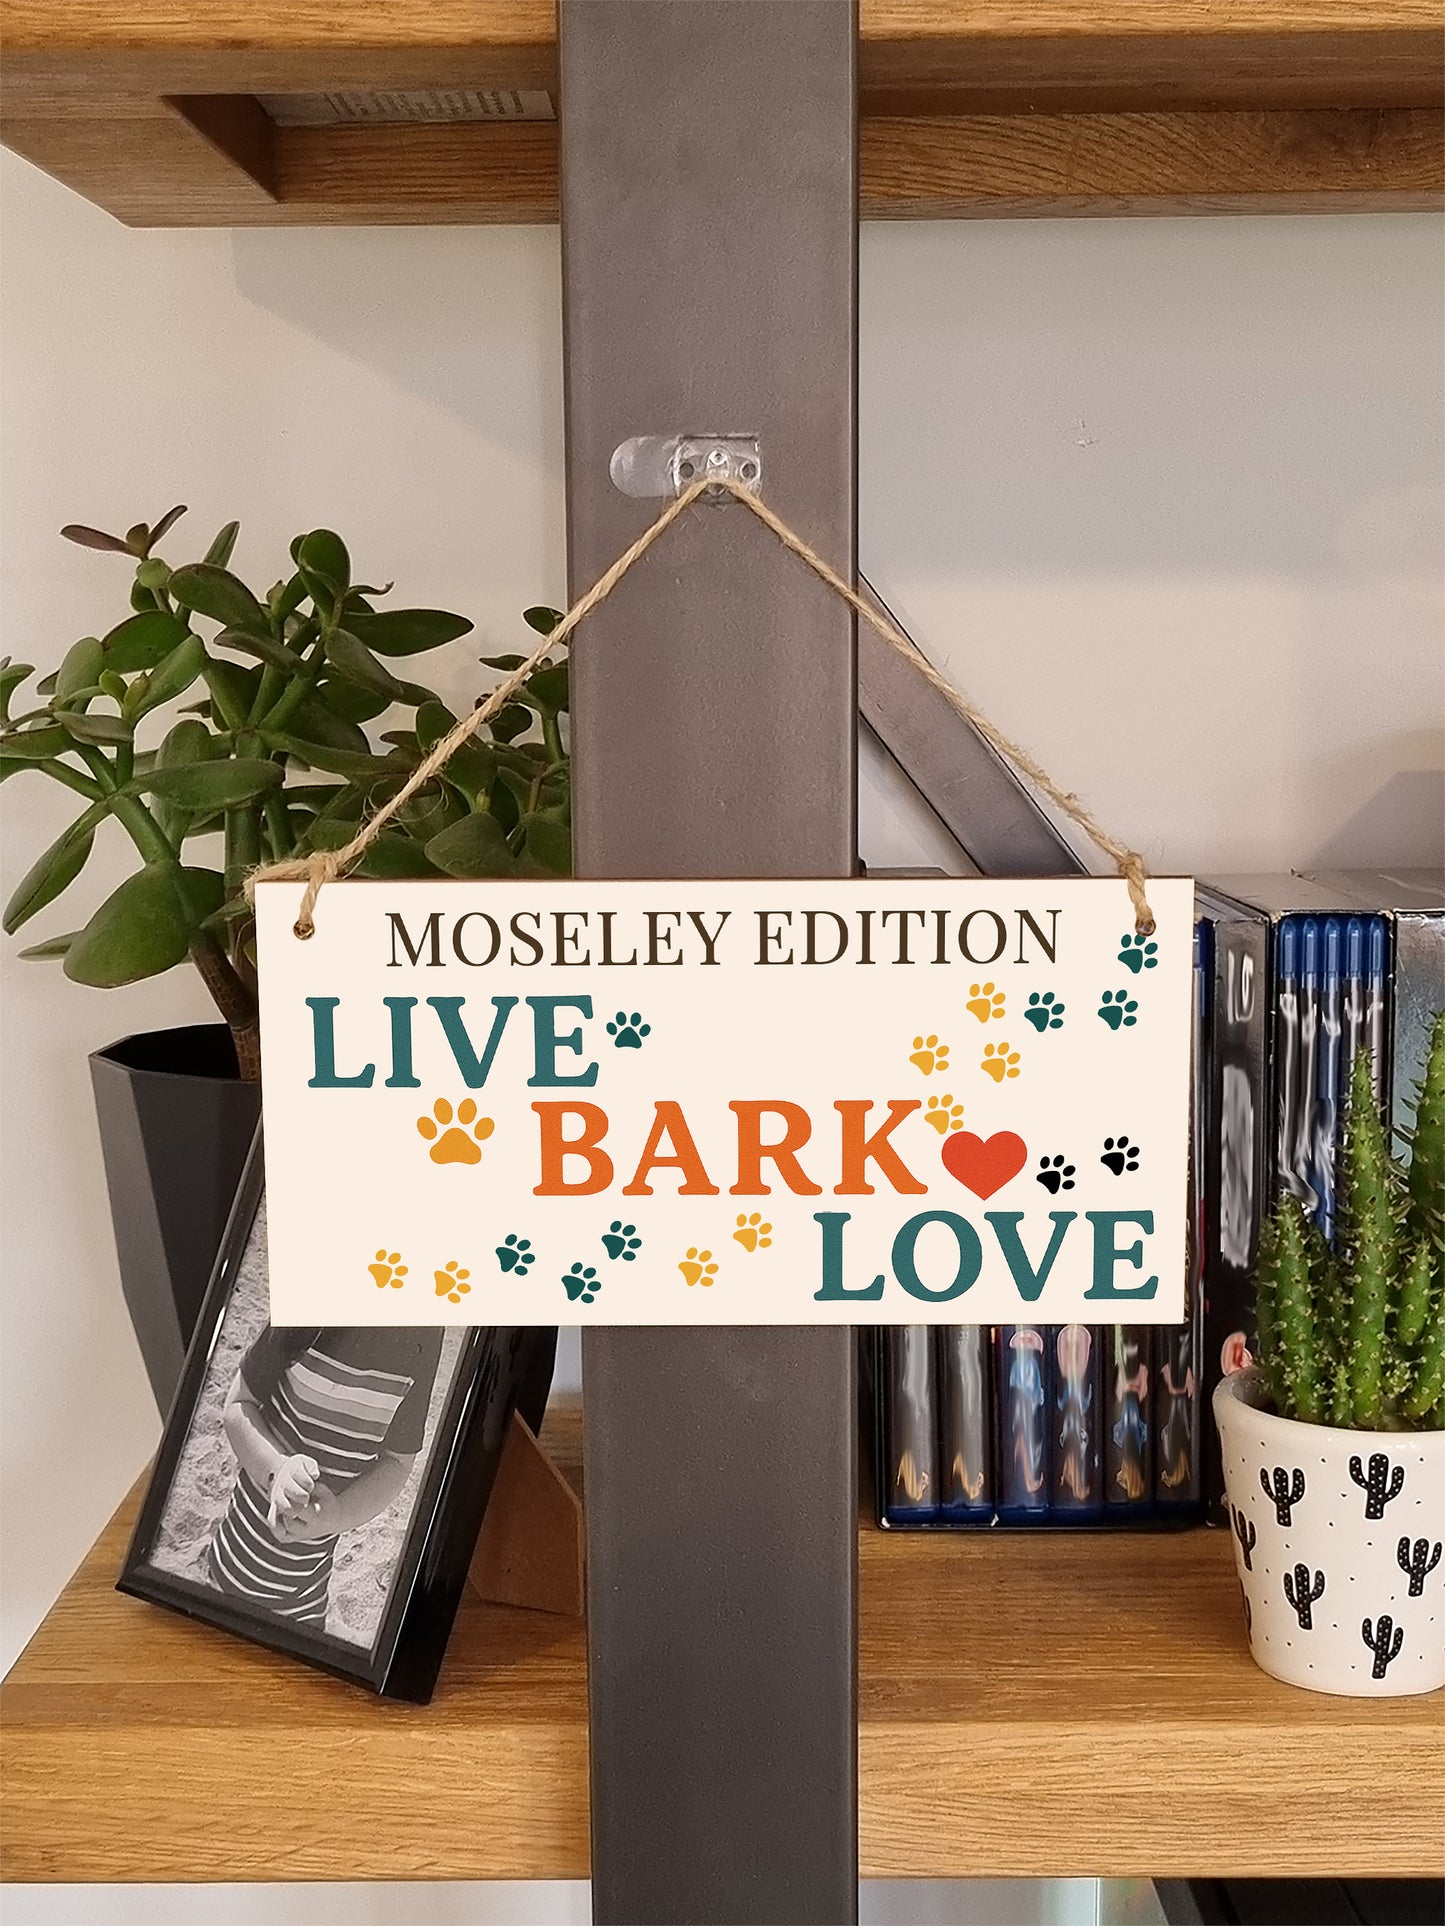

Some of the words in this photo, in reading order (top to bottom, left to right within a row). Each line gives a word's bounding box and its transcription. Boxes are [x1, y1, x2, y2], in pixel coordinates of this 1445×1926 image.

[385, 911, 733, 968] MOSELEY
[753, 909, 1063, 966] EDITION
[305, 994, 601, 1089] LIVE
[531, 1100, 930, 1197] BARK
[813, 1209, 1160, 1303] LOVE
